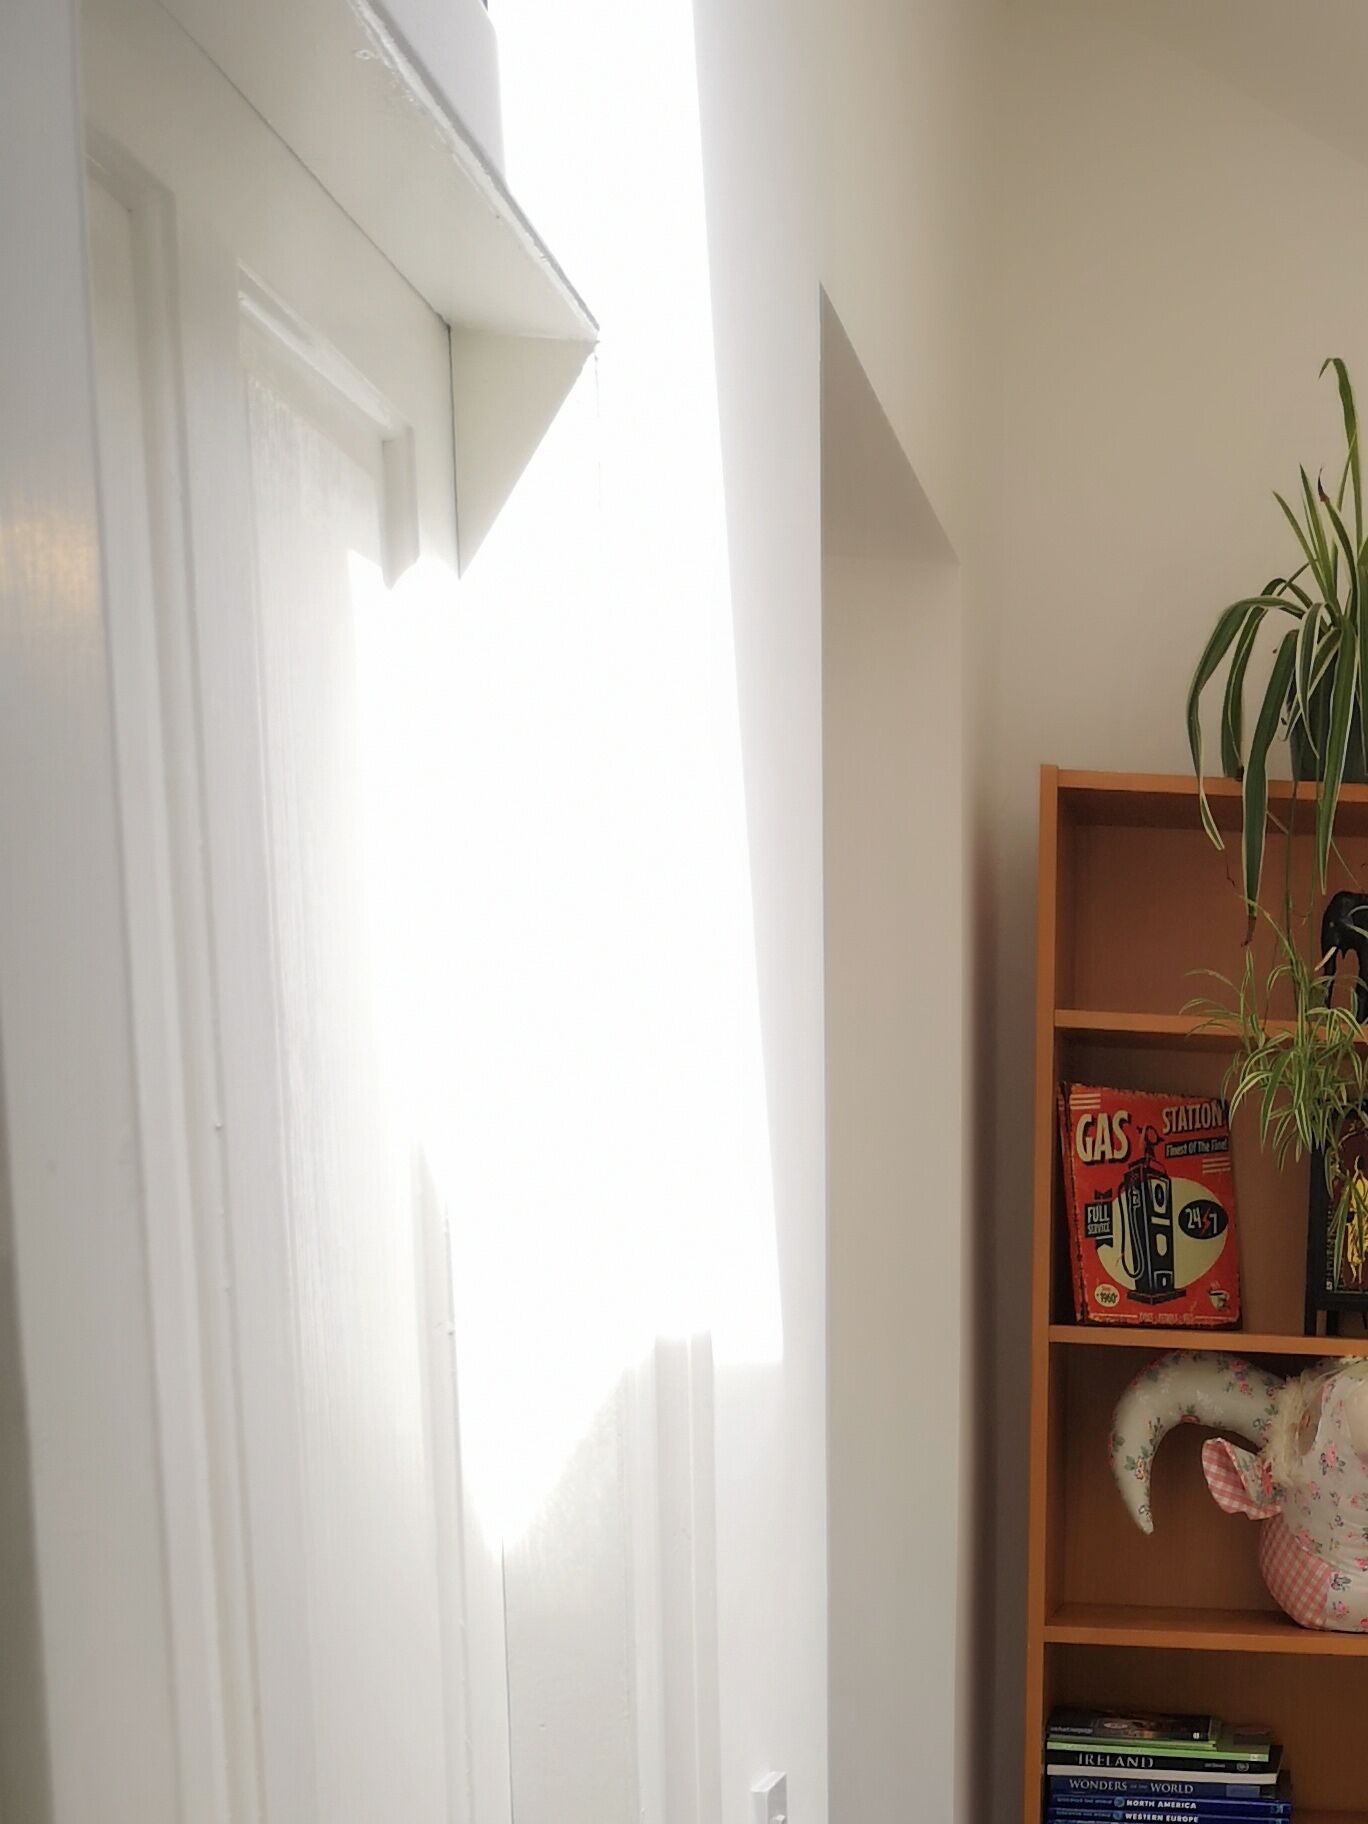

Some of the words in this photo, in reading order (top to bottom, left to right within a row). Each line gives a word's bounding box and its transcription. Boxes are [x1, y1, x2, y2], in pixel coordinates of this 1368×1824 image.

[1162, 1101, 1223, 1134] STATION
[1076, 1110, 1128, 1162] GAS
[1087, 1204, 1110, 1224] FULL
[1185, 1207, 1202, 1229] 24
[1209, 1212, 1218, 1234] 7
[1087, 1221, 1110, 1235] SERVICE
[1078, 1752, 1154, 1768] IRELAND
[1069, 1778, 1128, 1791] WONDERS
[1151, 1782, 1194, 1795] WORLD
[1126, 1798, 1155, 1808] NORTH
[1157, 1800, 1197, 1809] AMERICA
[1125, 1812, 1163, 1822] WESTERN
[1166, 1814, 1199, 1823] EUROPE
